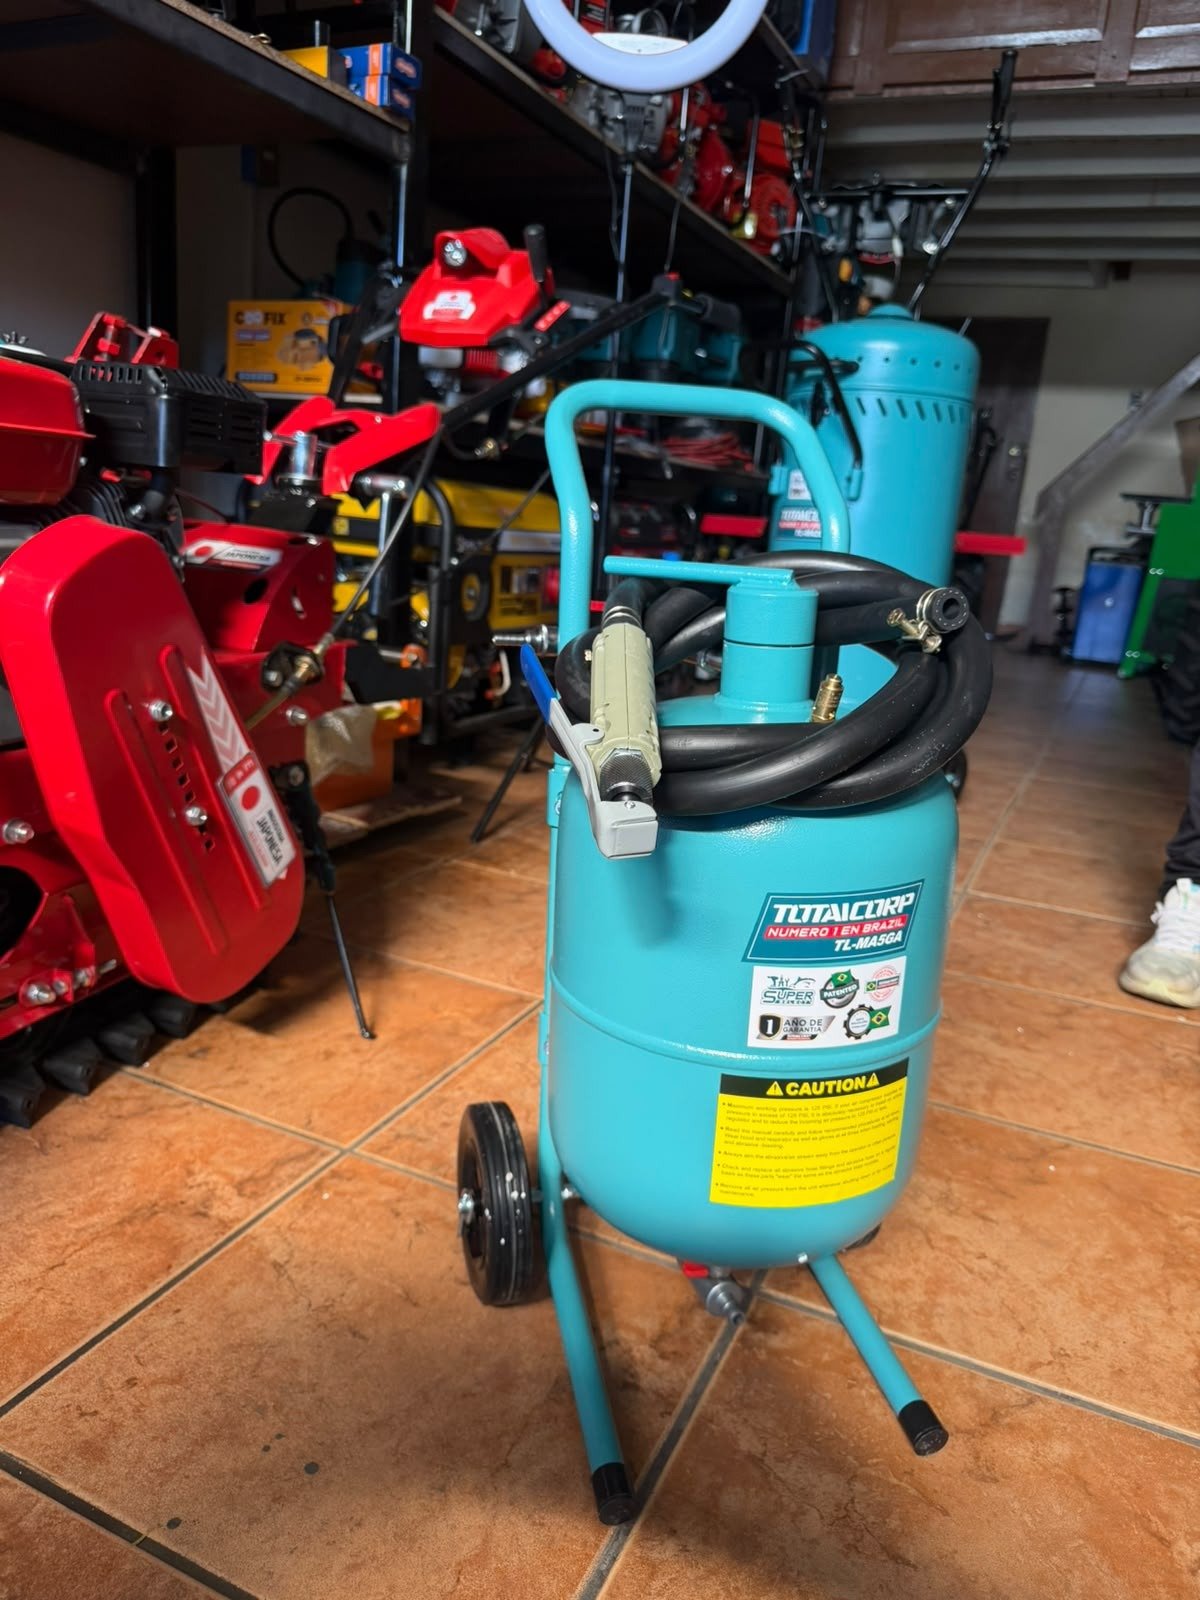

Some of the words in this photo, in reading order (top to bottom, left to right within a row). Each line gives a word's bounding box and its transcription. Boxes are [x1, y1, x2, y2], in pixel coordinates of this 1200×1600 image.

[767, 926, 828, 938] NUMERO
[832, 926, 837, 936] 1
[841, 923, 859, 935] EN
[862, 917, 905, 934] BRAZIL
[834, 930, 903, 952] TL-MA5GA
[763, 989, 814, 1004] SUPER
[823, 984, 858, 998] PATENTED
[766, 1019, 774, 1035] 1
[784, 1016, 807, 1027] AÑO
[809, 1018, 823, 1026] DE
[785, 1076, 866, 1096] CAUTION
